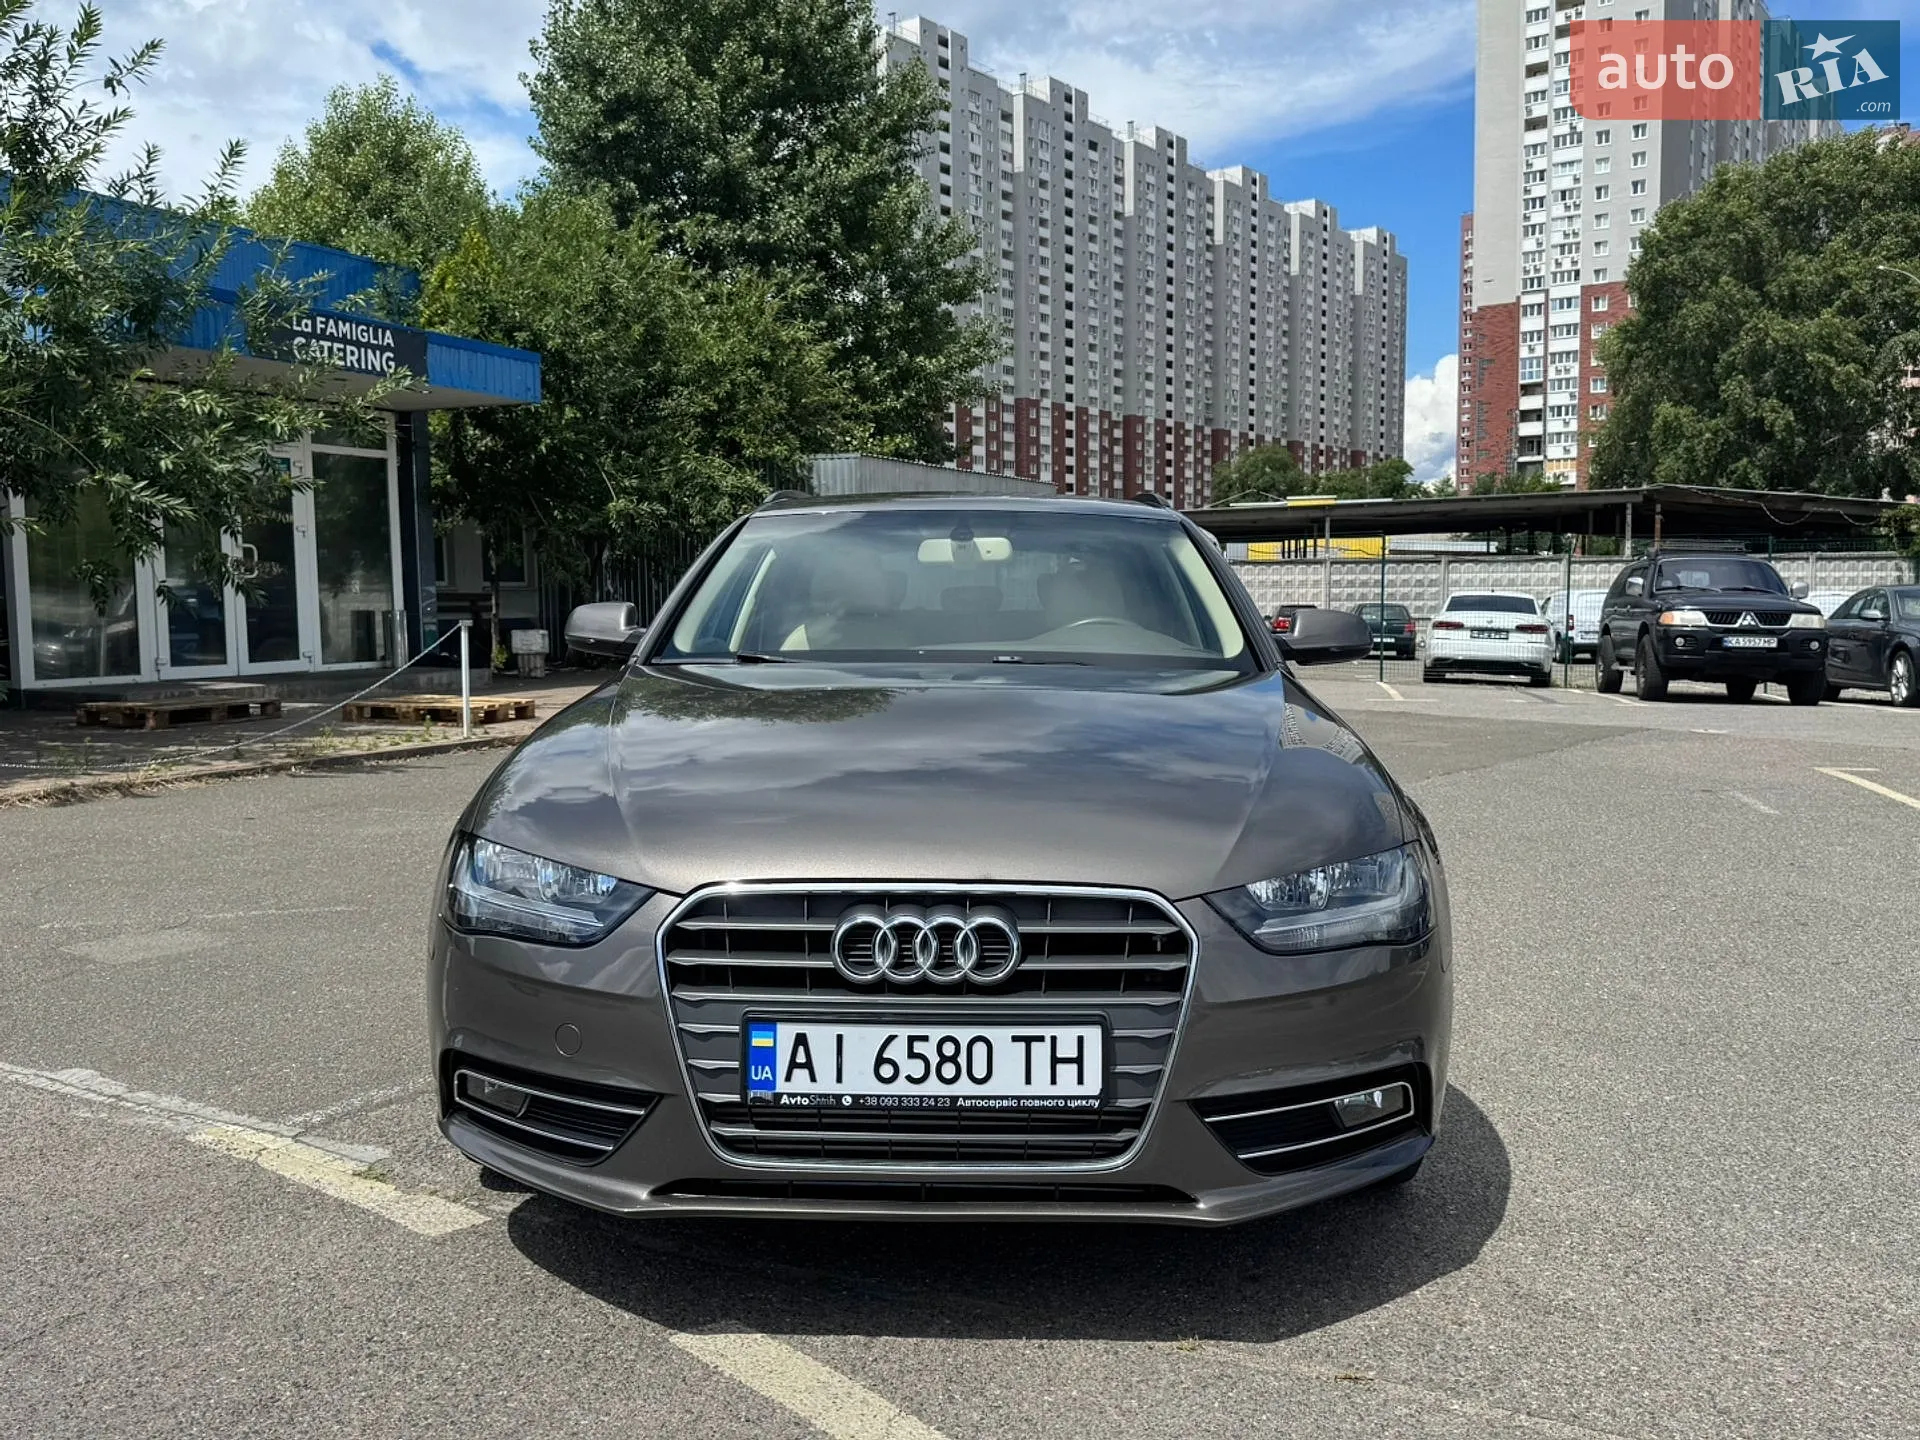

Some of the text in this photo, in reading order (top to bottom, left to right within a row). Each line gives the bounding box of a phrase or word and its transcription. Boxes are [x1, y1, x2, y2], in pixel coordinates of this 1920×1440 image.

[292, 312, 395, 347] La FAMIGLIA
[784, 1032, 1084, 1086] AI 6580 TH
[752, 1065, 773, 1081] UA
[859, 1096, 950, 1107] +38 093 333 24 23
[956, 1096, 1100, 1109] Автосервіс повного циклу
